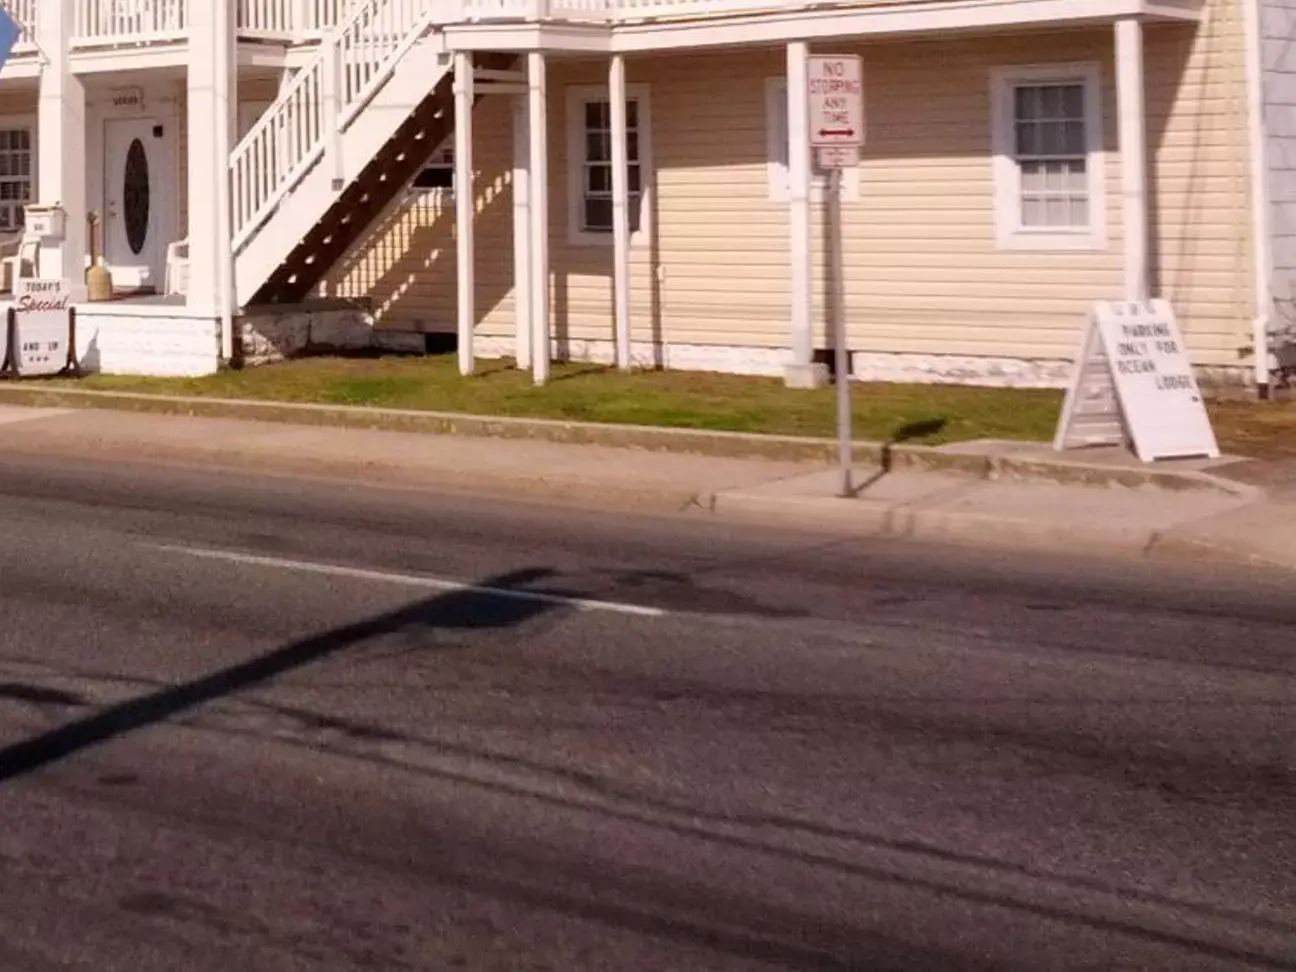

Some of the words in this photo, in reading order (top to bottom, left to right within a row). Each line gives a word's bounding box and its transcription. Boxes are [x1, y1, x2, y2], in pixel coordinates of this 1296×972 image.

[823, 61, 844, 77] NO
[809, 78, 860, 95] STOPPING
[823, 96, 848, 109] ANY
[822, 110, 850, 125] TIME
[15, 294, 70, 314] Special
[1122, 323, 1171, 338] PARKING
[1156, 340, 1179, 355] FOR
[1154, 374, 1194, 391] LODGE
